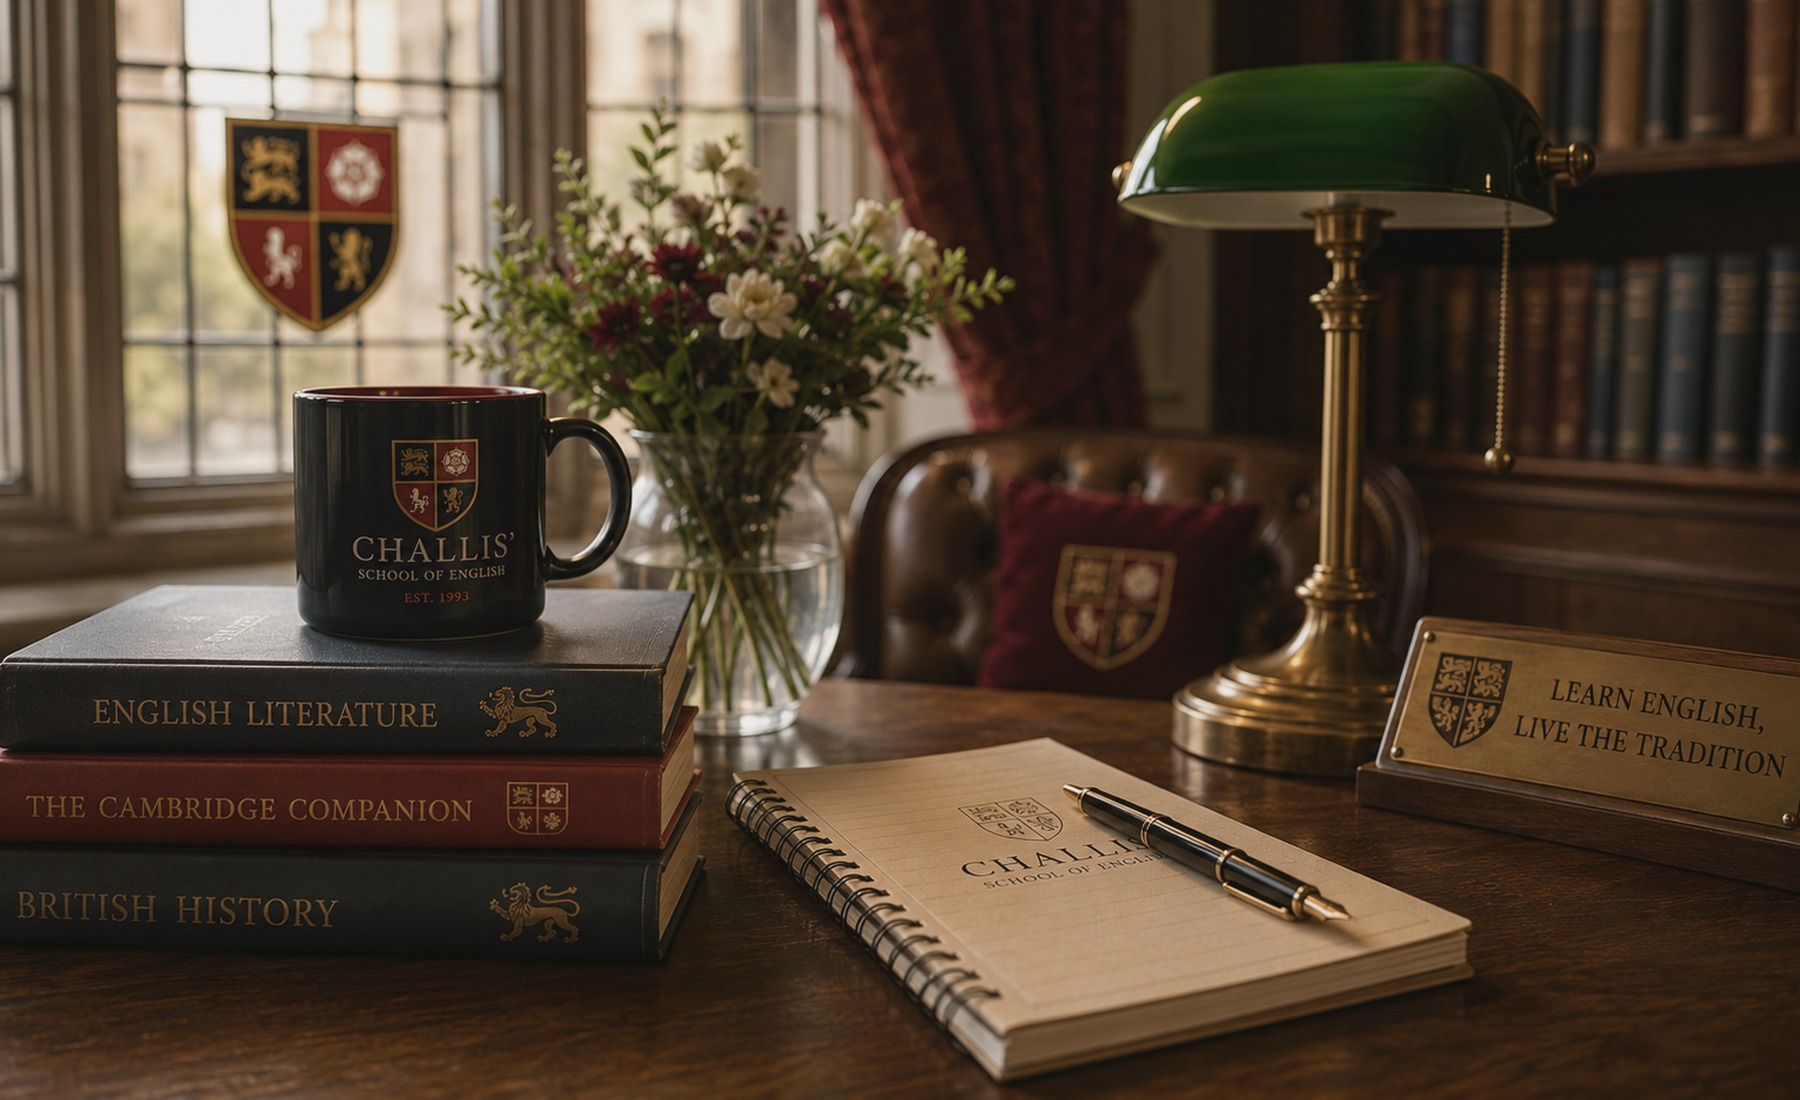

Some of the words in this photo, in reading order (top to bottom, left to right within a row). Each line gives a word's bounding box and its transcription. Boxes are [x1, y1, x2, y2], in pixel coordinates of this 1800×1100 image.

[358, 568, 419, 582] SCHOOL
[423, 569, 444, 582] OF
[449, 564, 506, 581] ENGLISH
[404, 592, 434, 604] EST.
[439, 590, 470, 604] 1993
[93, 698, 232, 727] ENGLISH
[246, 700, 439, 729] LITERATURE
[1550, 678, 1636, 711] LEARN
[1639, 690, 1765, 736] ENGLISH,
[1513, 714, 1571, 744] LIVE
[1577, 723, 1629, 753] THE
[1635, 732, 1788, 779] TRADITION
[25, 794, 87, 819] THE
[98, 795, 277, 822] CAMBRIDGE
[288, 798, 474, 823] COMPANION
[983, 871, 1065, 890] SCHOOL
[1067, 864, 1091, 876] OF
[17, 890, 158, 923] BRITISH
[176, 895, 339, 928] HISTORY
